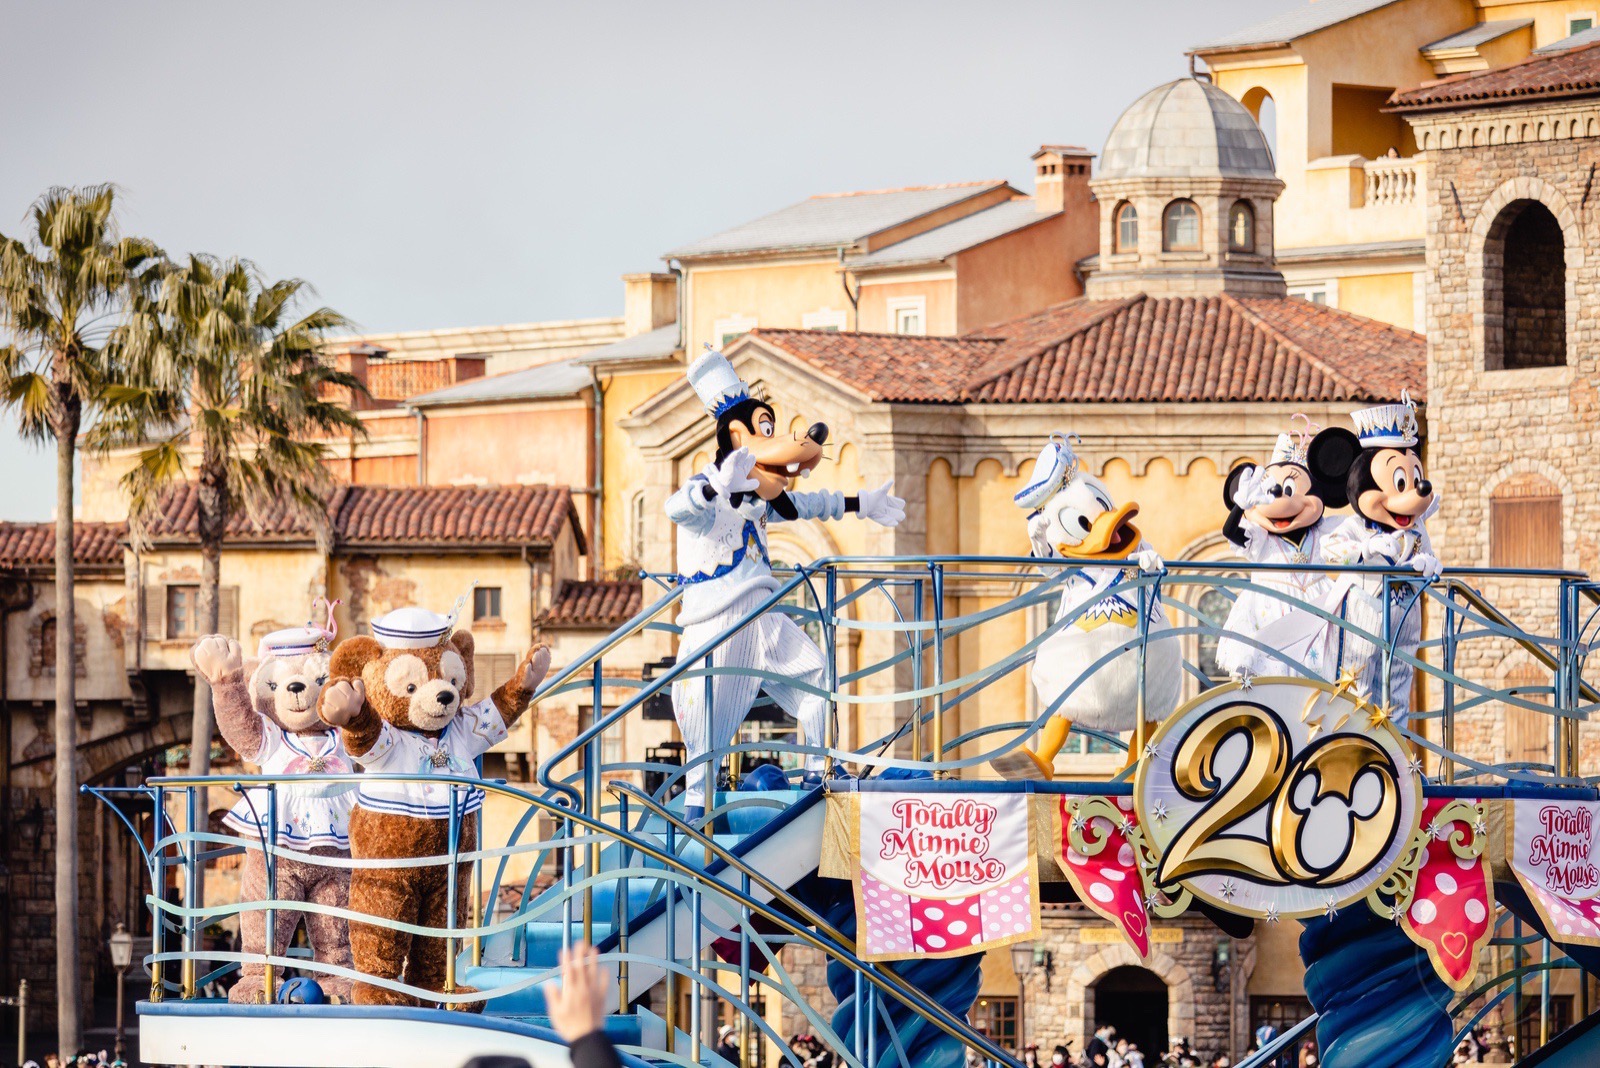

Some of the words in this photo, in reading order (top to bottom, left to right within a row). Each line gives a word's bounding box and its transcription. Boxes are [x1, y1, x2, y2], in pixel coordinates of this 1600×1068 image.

[1157, 701, 1401, 889] 20
[895, 801, 996, 834] Totally
[1541, 808, 1591, 841] Totally
[882, 828, 986, 859] Minnie
[1531, 834, 1589, 864] Minnie
[907, 856, 1003, 887] Mouse
[1548, 862, 1598, 892] Mouse
